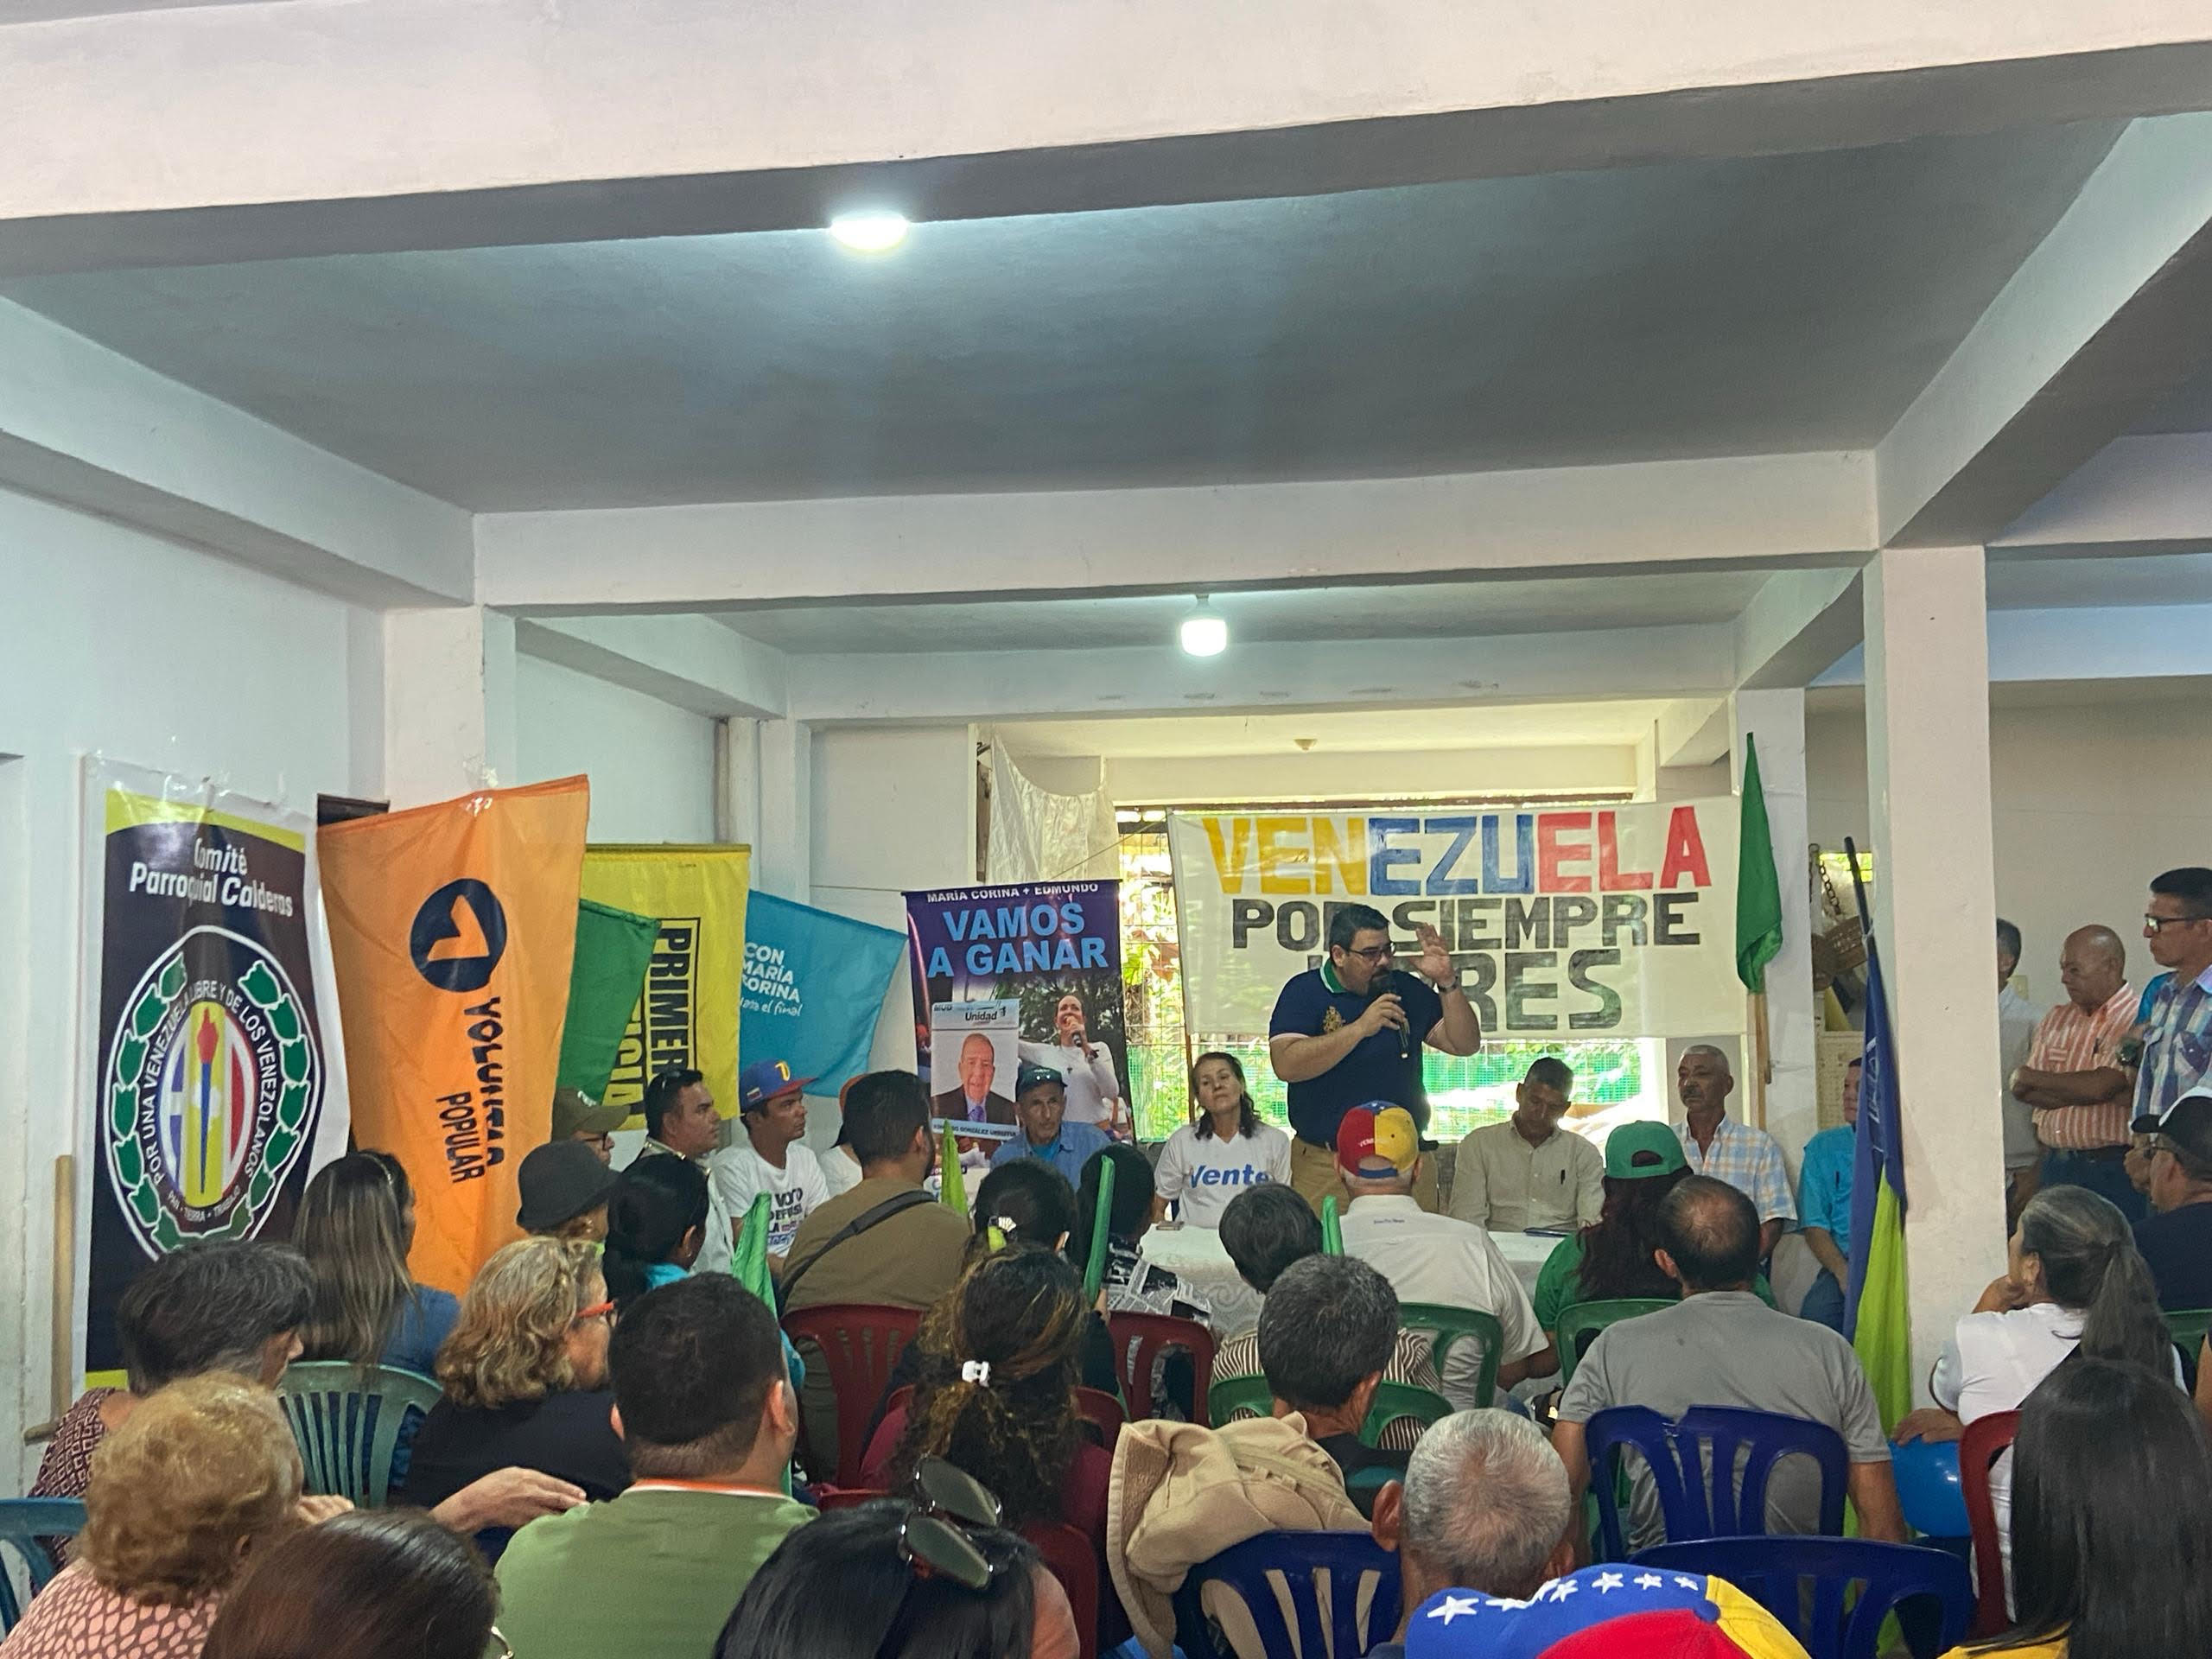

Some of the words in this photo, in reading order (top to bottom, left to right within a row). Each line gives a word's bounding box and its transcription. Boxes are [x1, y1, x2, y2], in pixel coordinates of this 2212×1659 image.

[1203, 805, 1713, 896] VENEZUELA
[927, 891, 968, 903] MARÍA
[971, 887, 1020, 899] CORINA
[1034, 883, 1099, 895] EDMUNDO
[943, 902, 1085, 941] VAMOS
[1392, 892, 1700, 951] SIEMPRE
[742, 960, 793, 984] MARÍA
[745, 942, 785, 965] CON
[927, 947, 955, 978] A
[965, 937, 1109, 976] GANAR
[226, 988, 243, 1014] DE
[650, 927, 691, 1075] PRIMER
[965, 1011, 997, 1021] Unidad
[238, 1005, 266, 1041] LOS
[142, 1094, 156, 1140] UNA
[245, 1039, 277, 1179] VENEZOLANOS
[435, 1090, 486, 1184] POPULAR
[145, 1141, 166, 1186] POR
[1191, 1164, 1269, 1189] Vente
